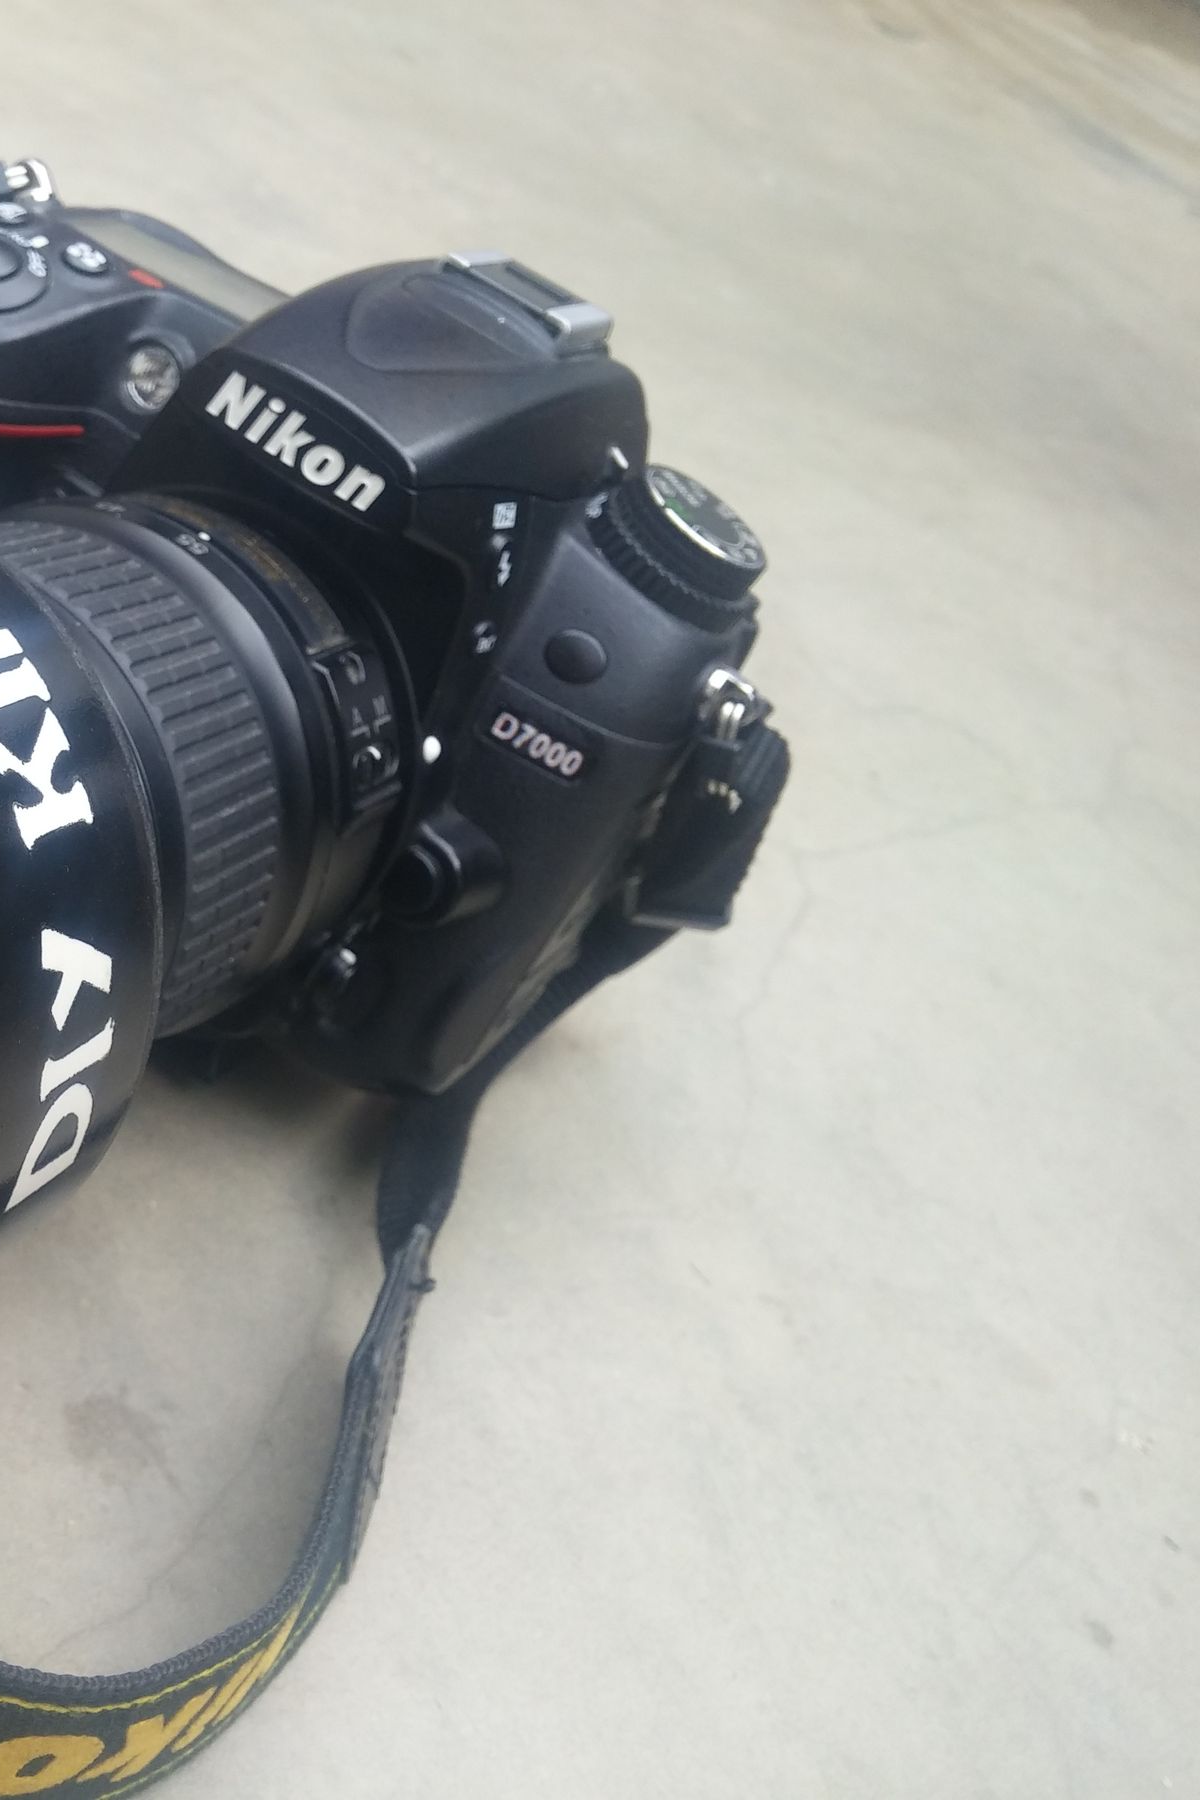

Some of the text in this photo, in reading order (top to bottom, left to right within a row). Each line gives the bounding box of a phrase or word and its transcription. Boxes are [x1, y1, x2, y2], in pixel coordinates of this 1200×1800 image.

[204, 370, 387, 512] Nikon
[490, 710, 584, 778] D7000
[4, 928, 114, 1213] DIY
